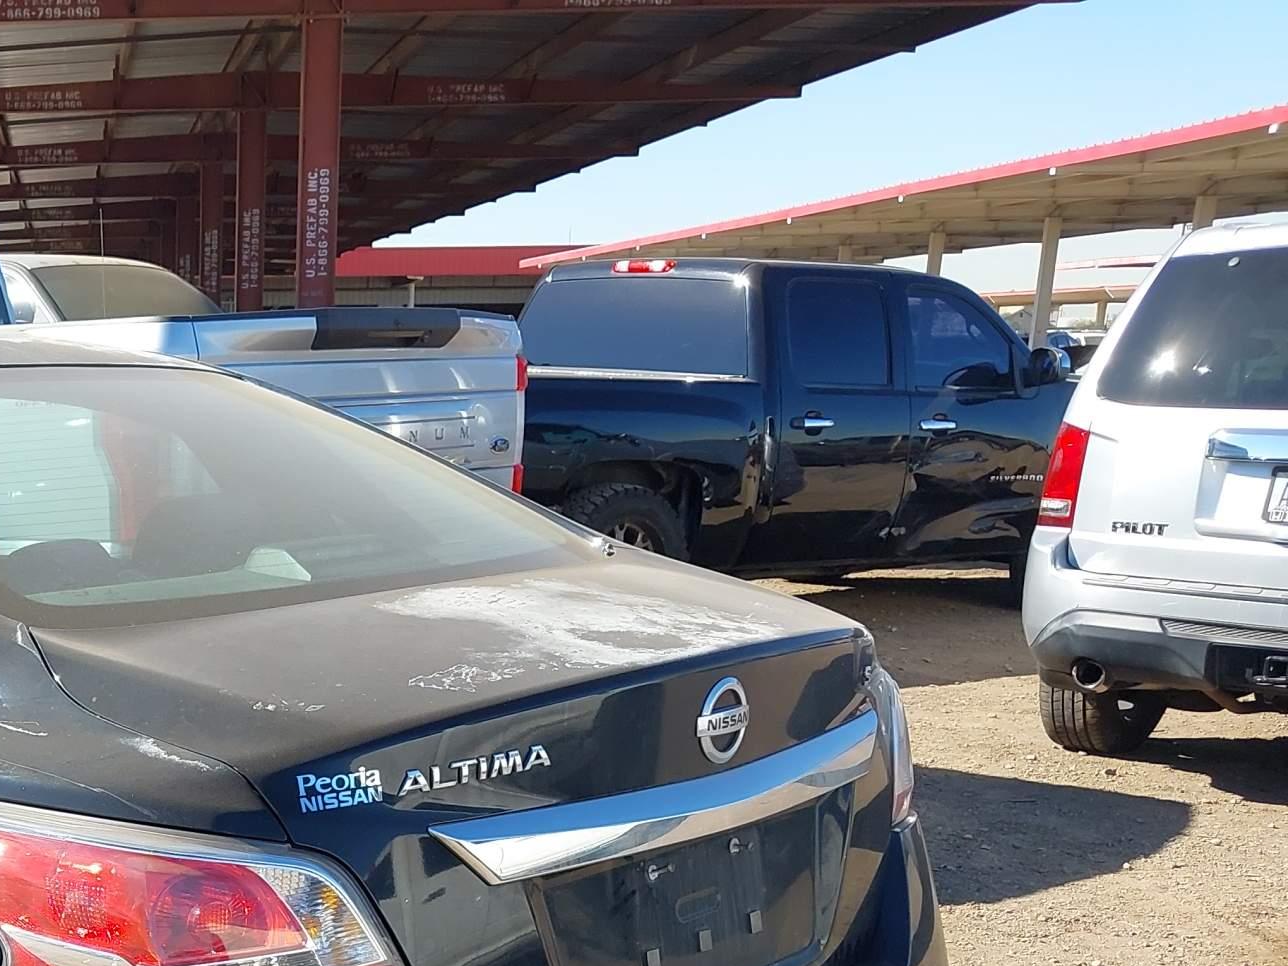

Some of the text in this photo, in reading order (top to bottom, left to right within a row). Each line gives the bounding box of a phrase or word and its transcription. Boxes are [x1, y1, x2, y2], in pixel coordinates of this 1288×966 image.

[305, 167, 319, 278] U.S. PREFAB INC.
[317, 168, 330, 276] 1-866-799-0969
[242, 230, 251, 267] PREFAB
[1112, 521, 1169, 536] PILOT
[707, 709, 749, 732] NISSAN
[296, 744, 553, 798] Peoria ALTIMA
[300, 786, 384, 814] NISSAN
